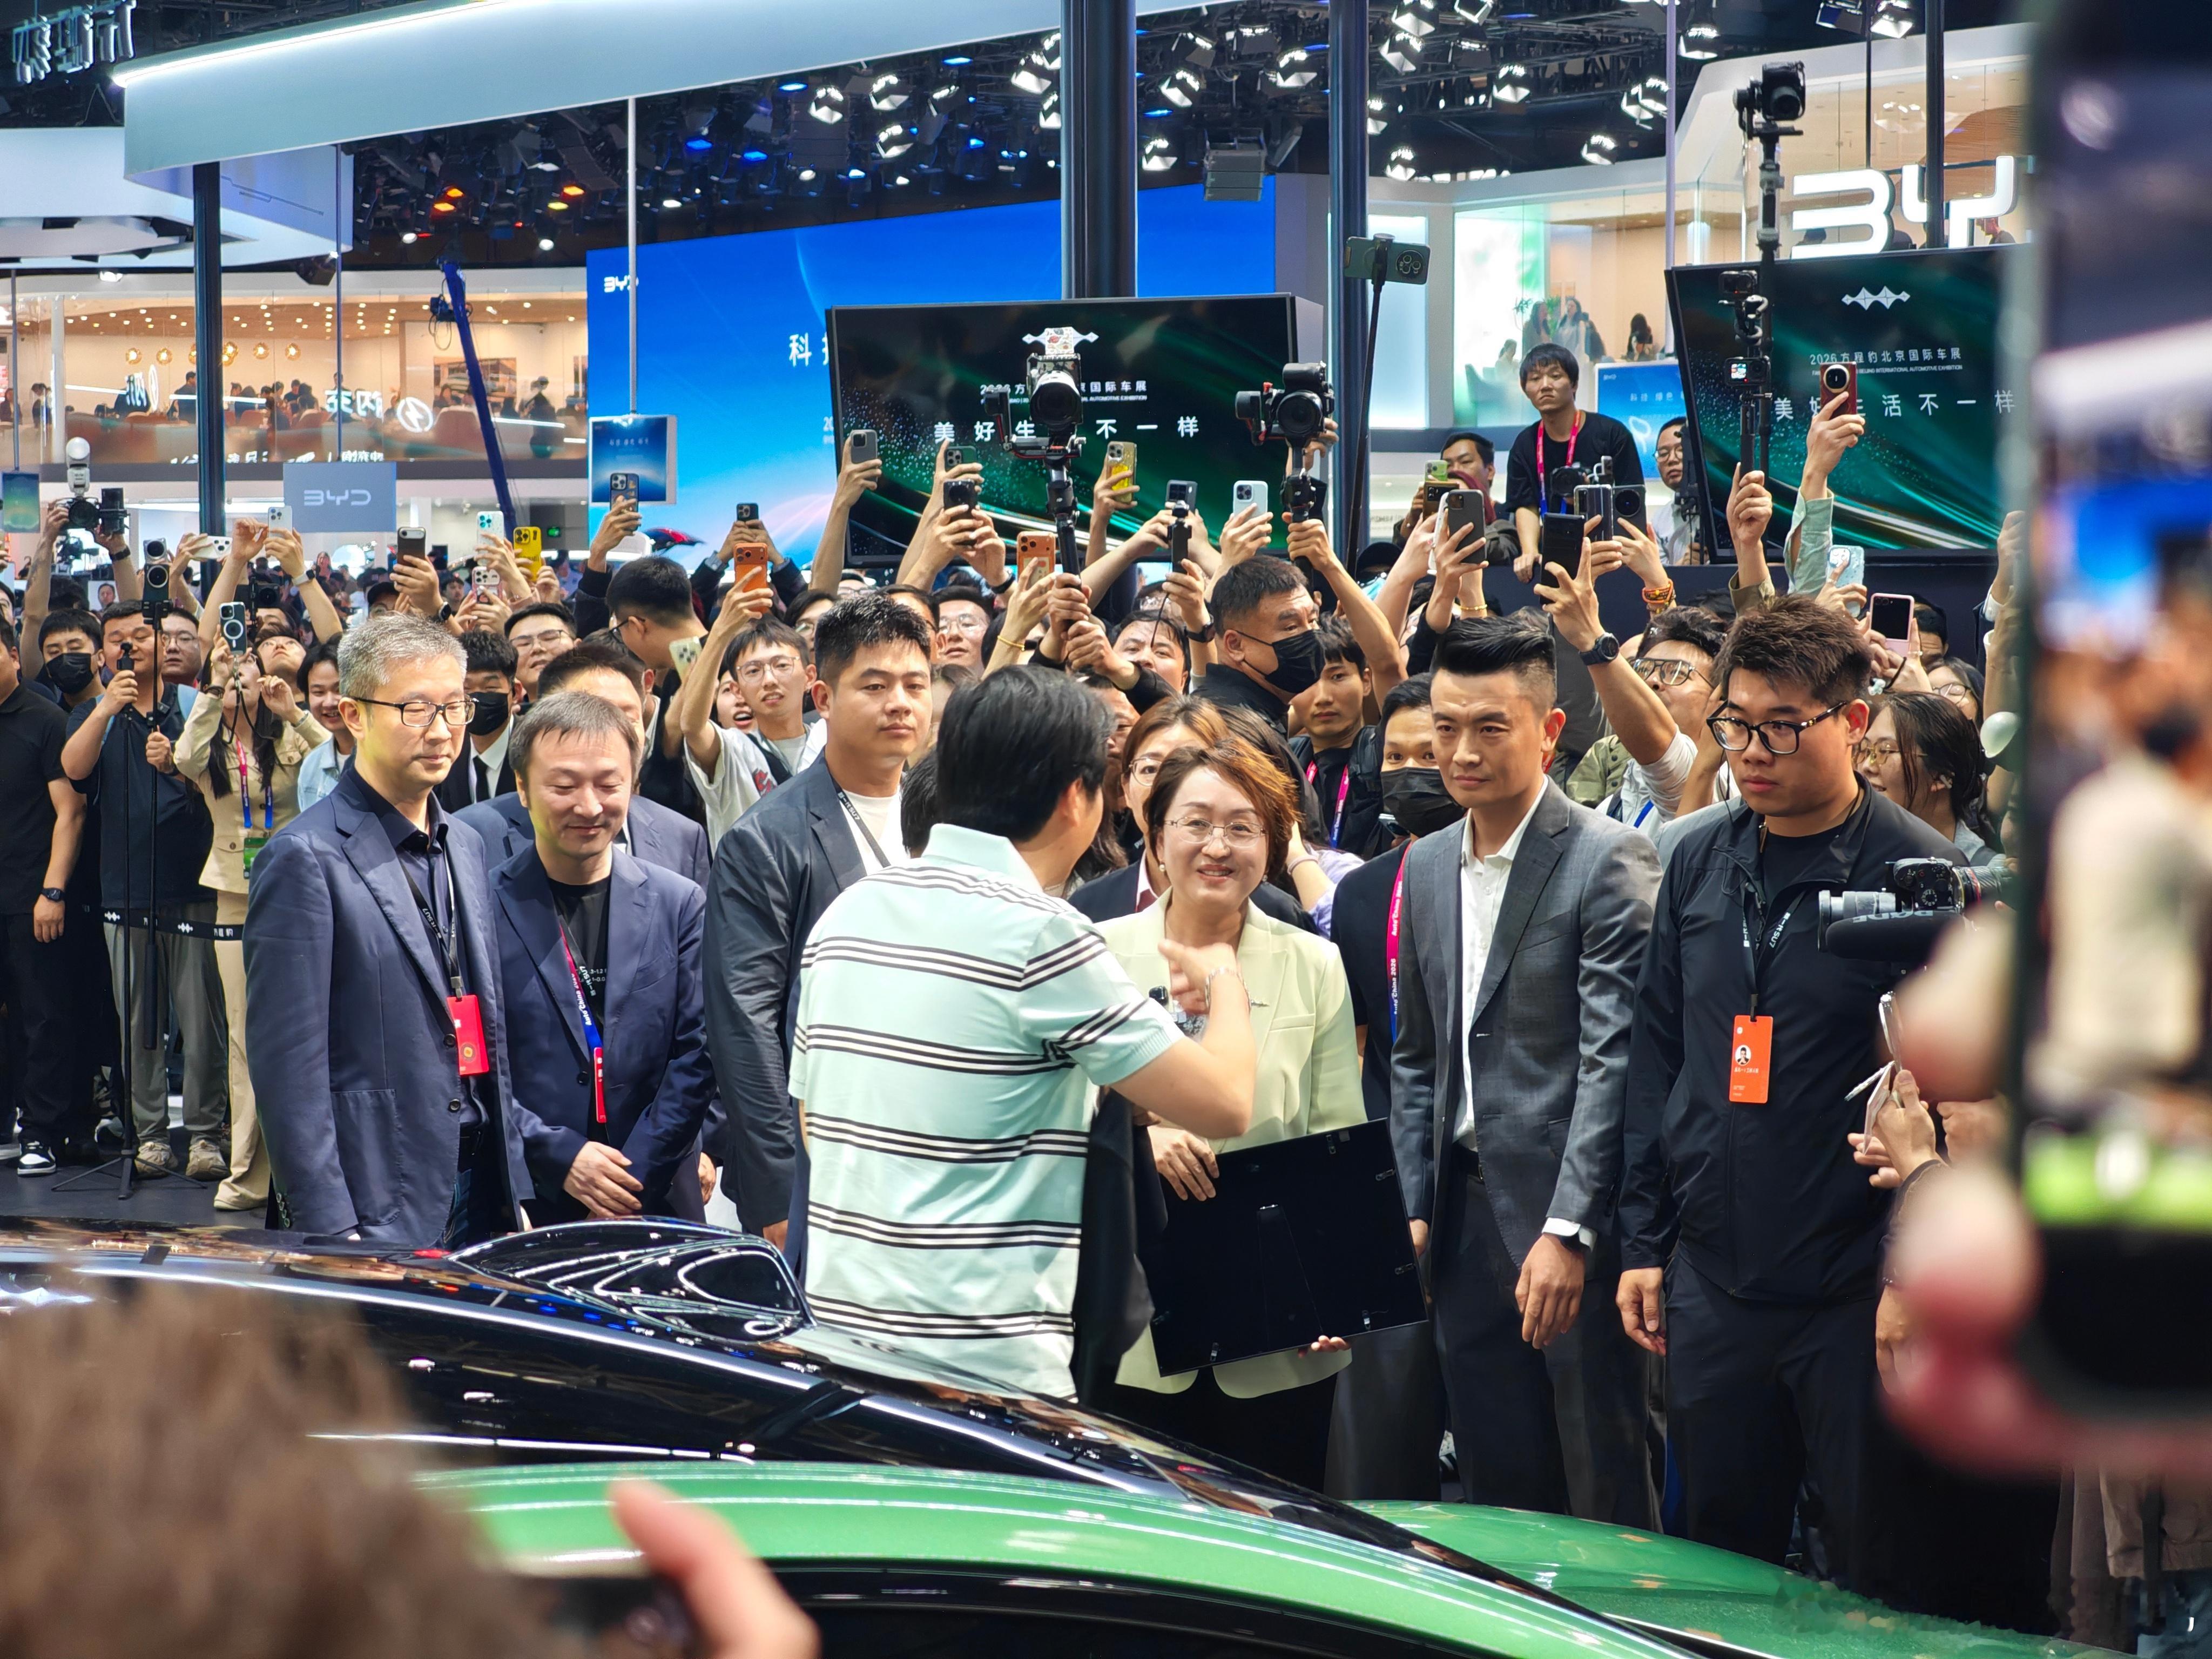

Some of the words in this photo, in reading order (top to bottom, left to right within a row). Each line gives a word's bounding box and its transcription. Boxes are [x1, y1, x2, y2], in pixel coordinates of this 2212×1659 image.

[934, 416, 1198, 442] 美好生不一样
[304, 489, 372, 506] BYD
[576, 990, 586, 1013] China
[583, 1010, 592, 1026] Auto
